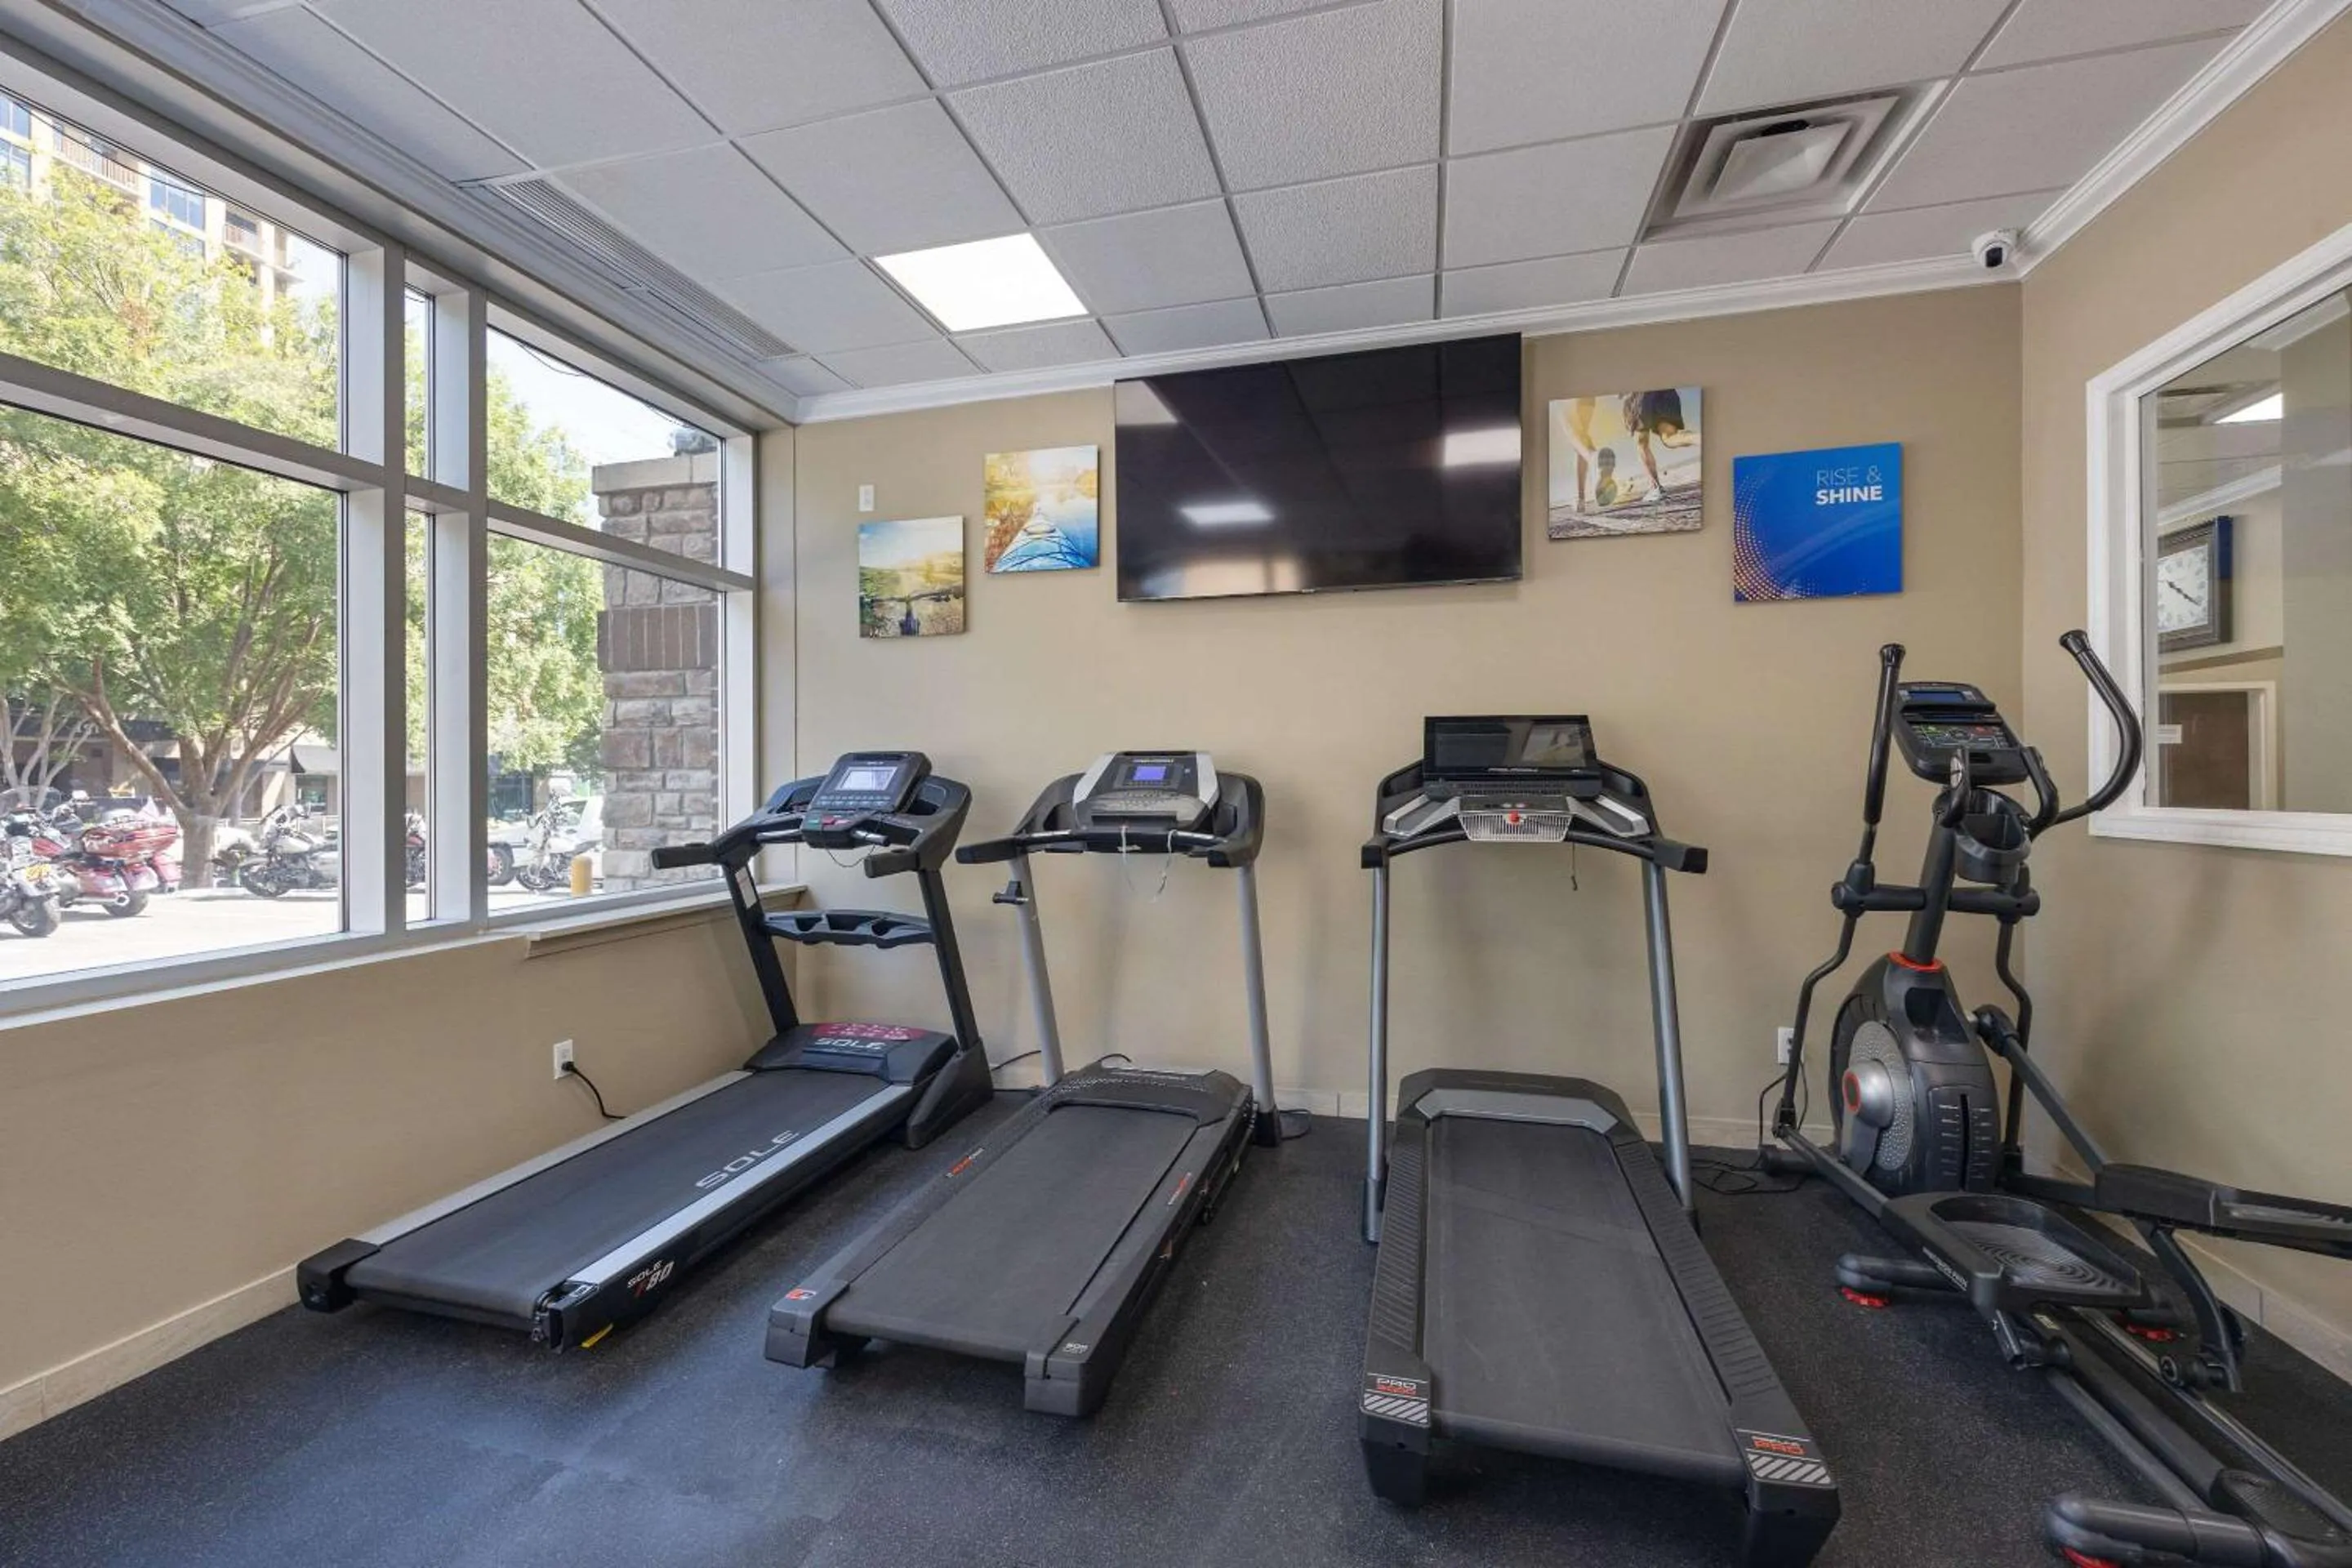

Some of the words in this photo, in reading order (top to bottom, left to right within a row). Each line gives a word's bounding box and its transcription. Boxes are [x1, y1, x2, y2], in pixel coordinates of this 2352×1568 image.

[1816, 466, 1859, 488] RISE
[1867, 465, 1882, 485] &
[1815, 485, 1882, 506] SHINE
[814, 1037, 886, 1050] SOLE
[694, 1129, 800, 1189] SOLE
[627, 1260, 662, 1289] SOLE
